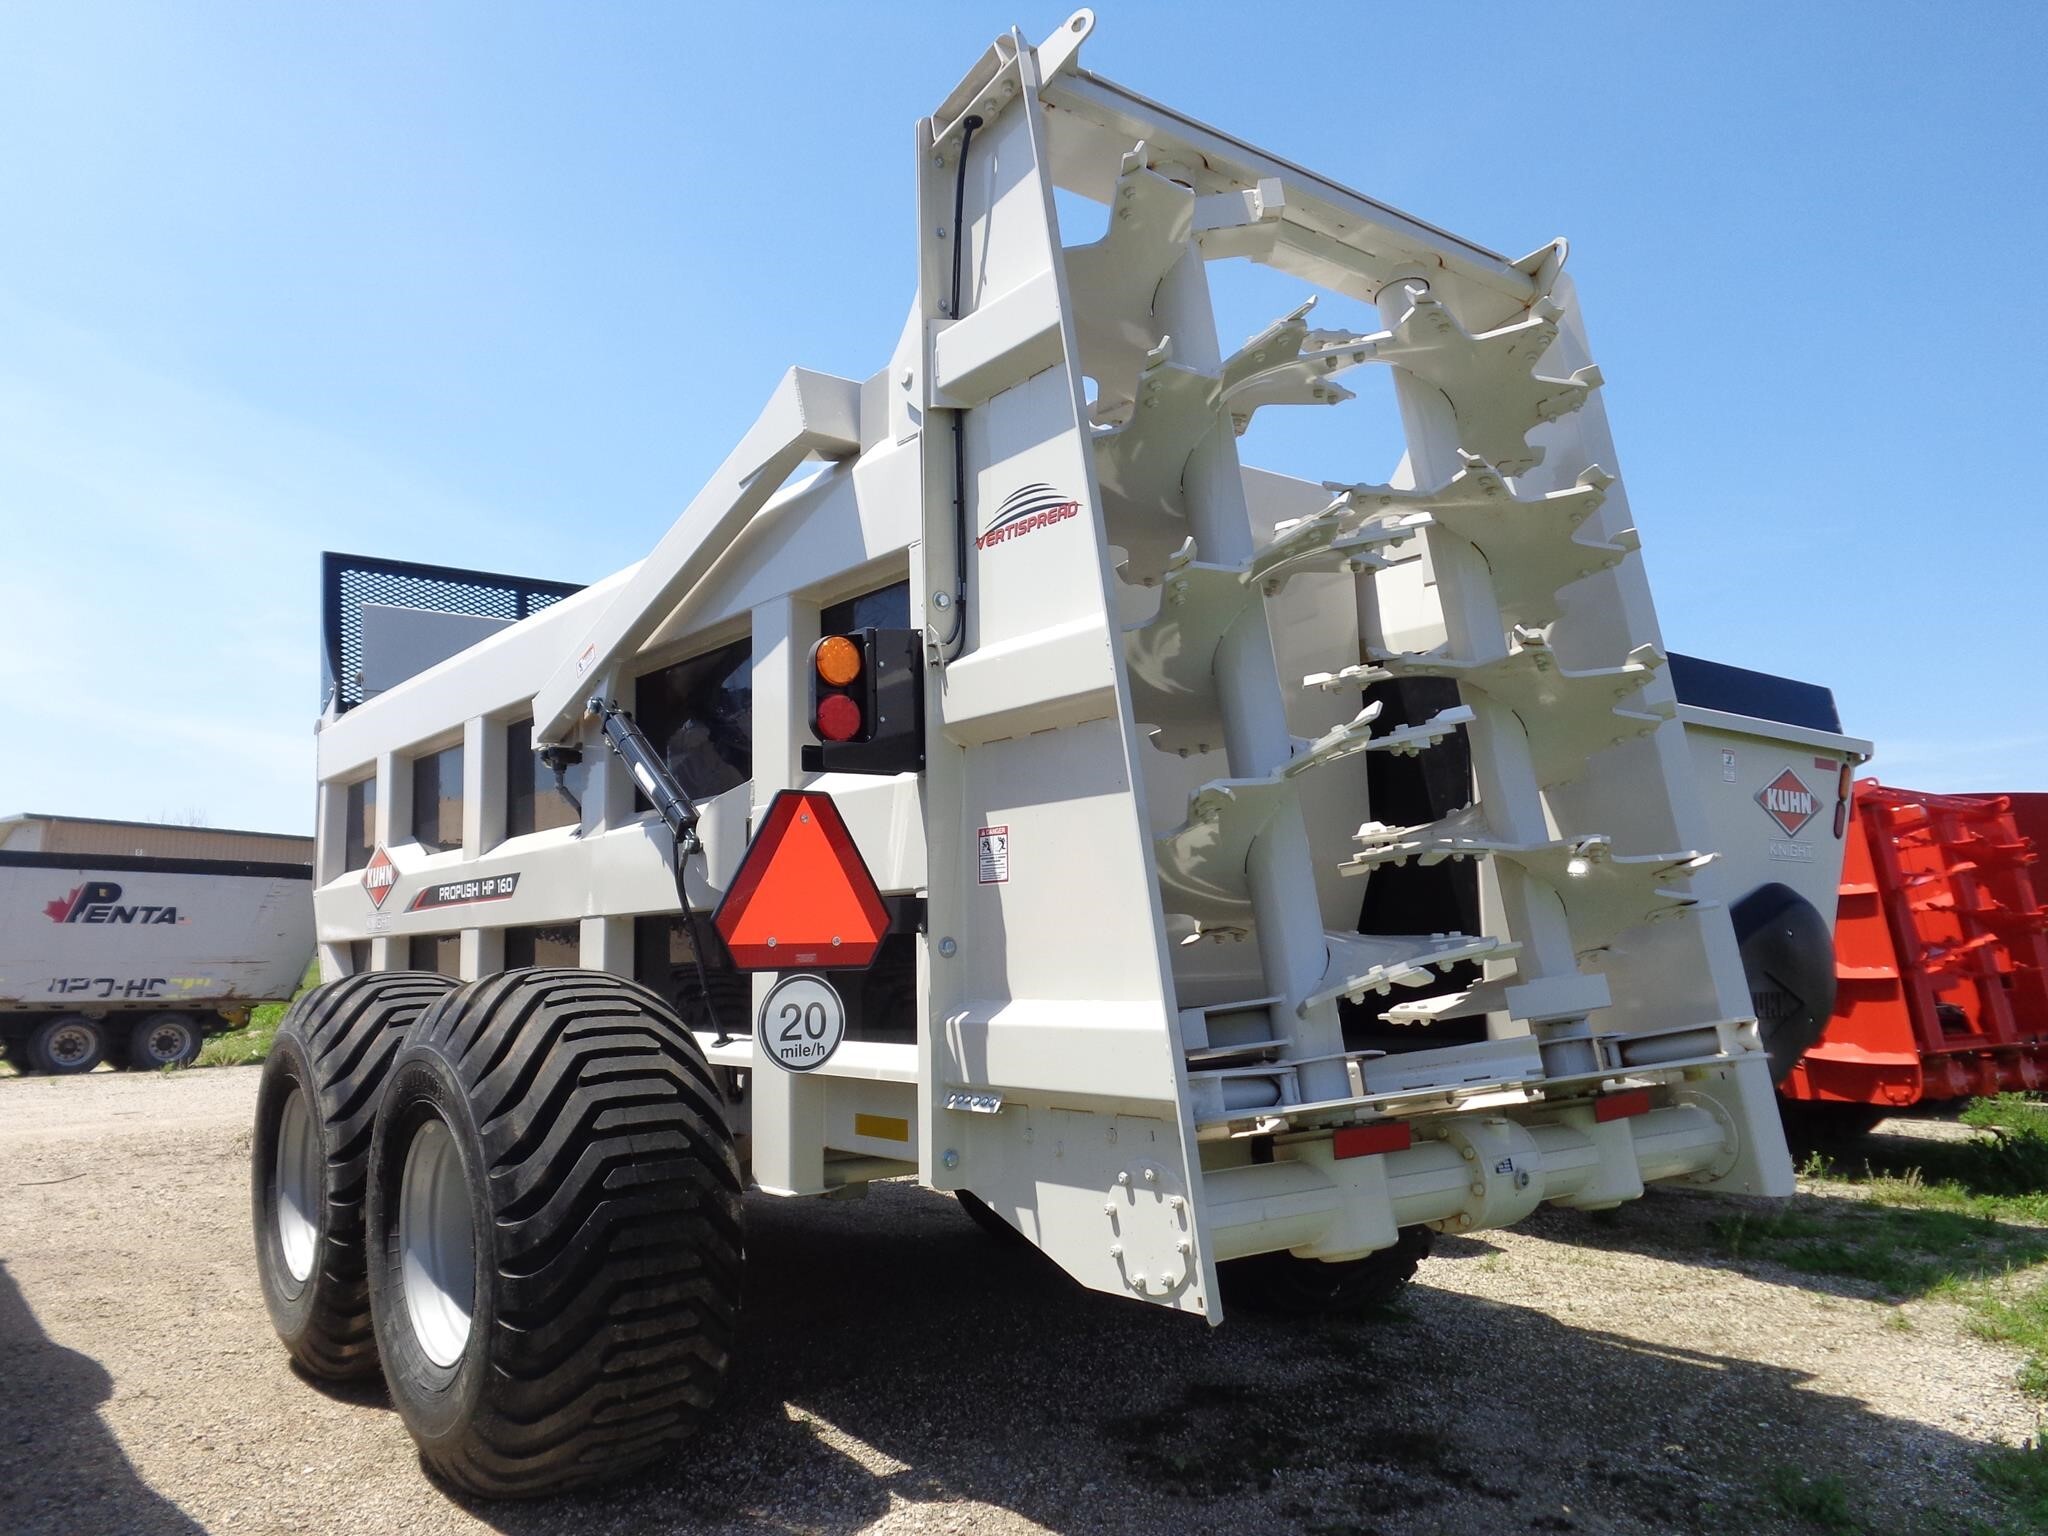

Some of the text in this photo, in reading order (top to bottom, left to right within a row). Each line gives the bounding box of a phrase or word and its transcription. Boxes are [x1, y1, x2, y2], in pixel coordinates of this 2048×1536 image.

[975, 500, 1079, 551] VERTISPREAD
[1767, 788, 1812, 815] KUHN
[366, 865, 393, 889] KUHN
[439, 876, 513, 901] PROPUSH HP 160
[67, 881, 177, 925] PENTA
[779, 1001, 827, 1042] 20
[780, 1042, 826, 1059] mile/h
